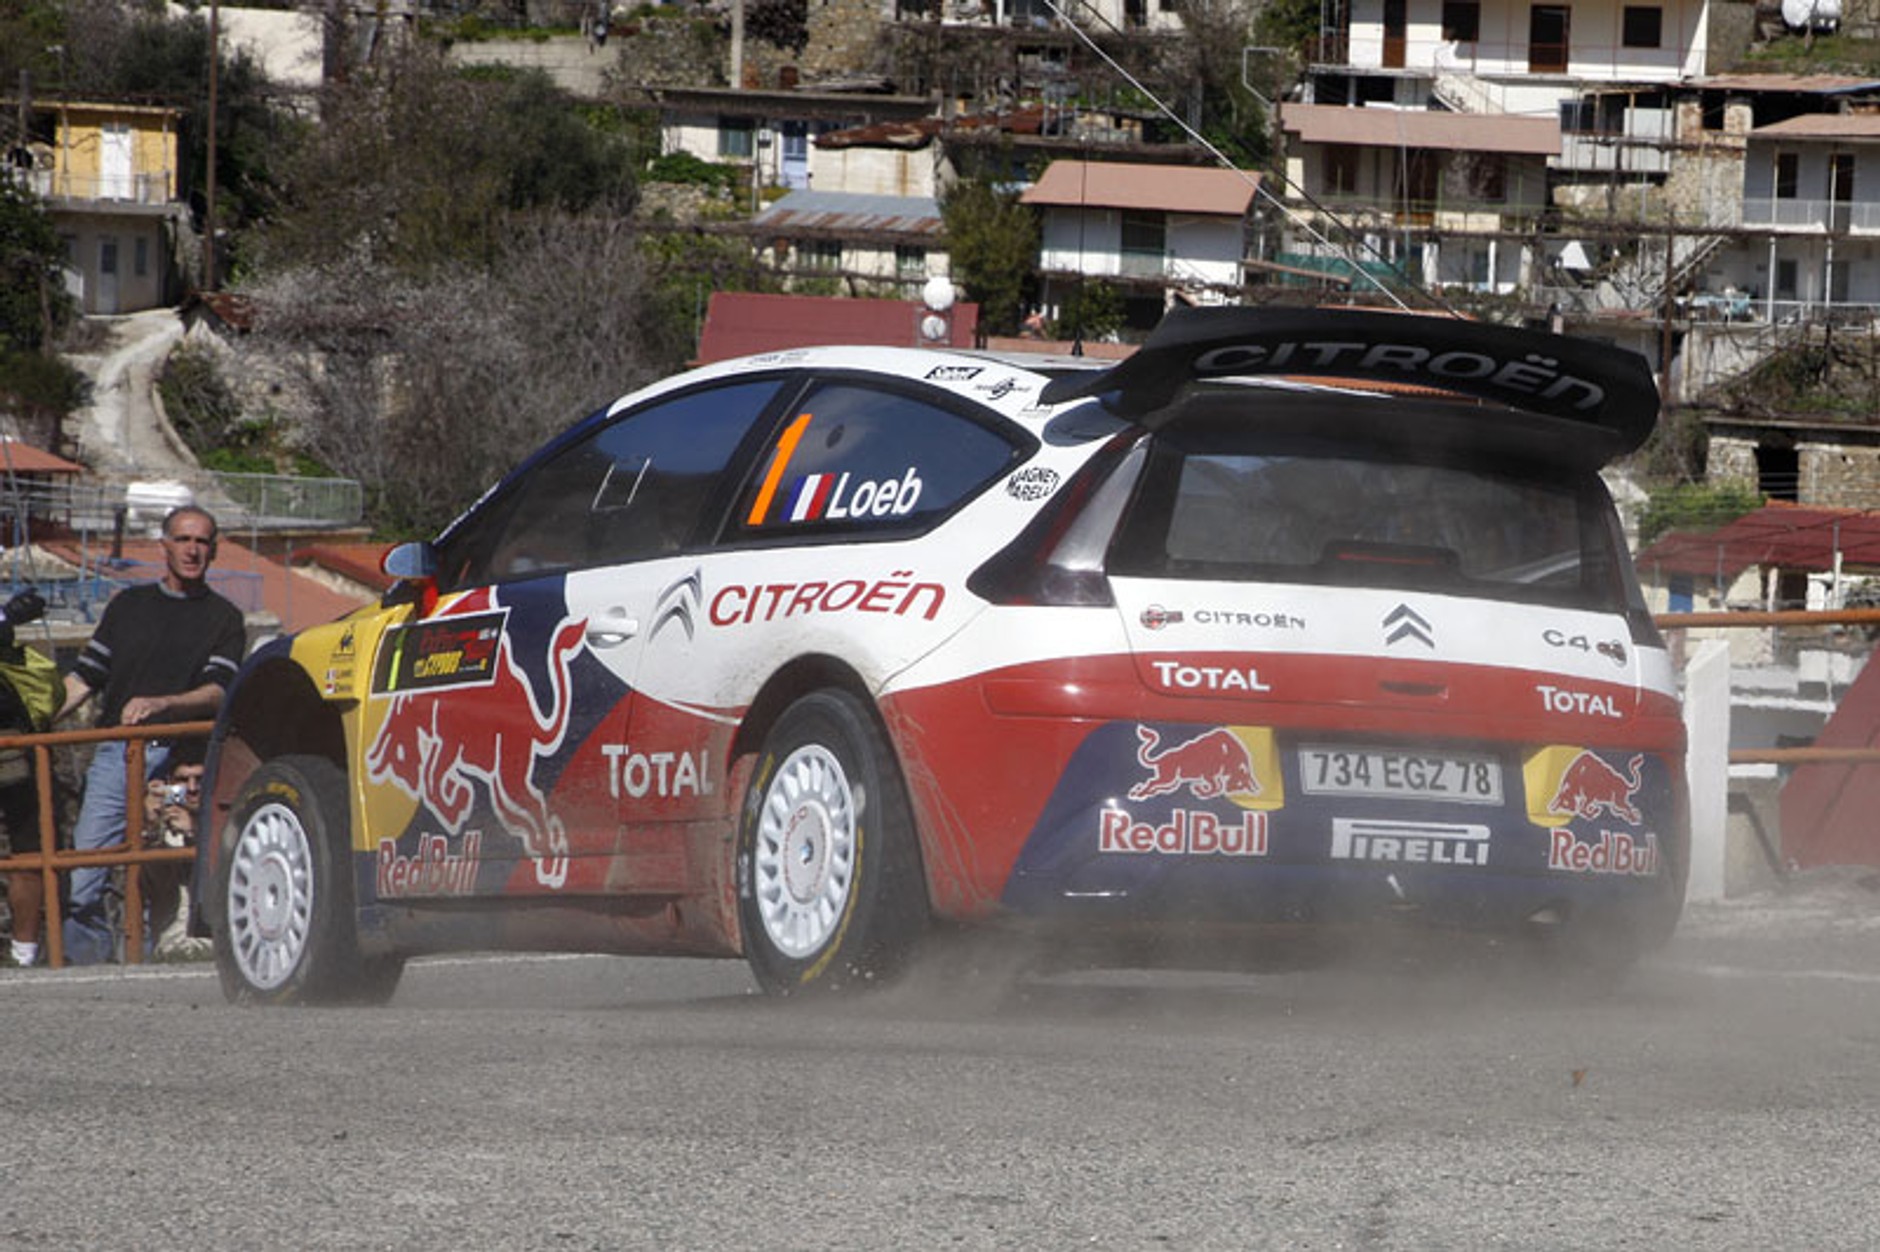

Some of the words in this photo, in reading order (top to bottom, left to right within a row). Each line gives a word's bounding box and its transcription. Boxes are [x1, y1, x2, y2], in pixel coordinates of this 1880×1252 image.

[1193, 341, 1605, 410] CITROËN
[747, 413, 813, 525] 1
[825, 467, 922, 518] Loeb
[709, 570, 946, 627] CITROËN
[1193, 610, 1306, 629] CITROËN
[1542, 629, 1591, 652] C4
[1152, 661, 1271, 692] TOTAL
[1536, 685, 1623, 718] TOTAL
[601, 744, 715, 799] TOTAL
[1312, 753, 1371, 787] 734
[1382, 756, 1448, 791] EGZ
[1455, 761, 1492, 795] 78
[1099, 807, 1185, 854] Red
[1189, 809, 1268, 856] Bull
[1330, 817, 1491, 866] PIRELLI
[1548, 827, 1611, 872] Red
[376, 831, 429, 898] Red
[430, 830, 482, 897] Bull
